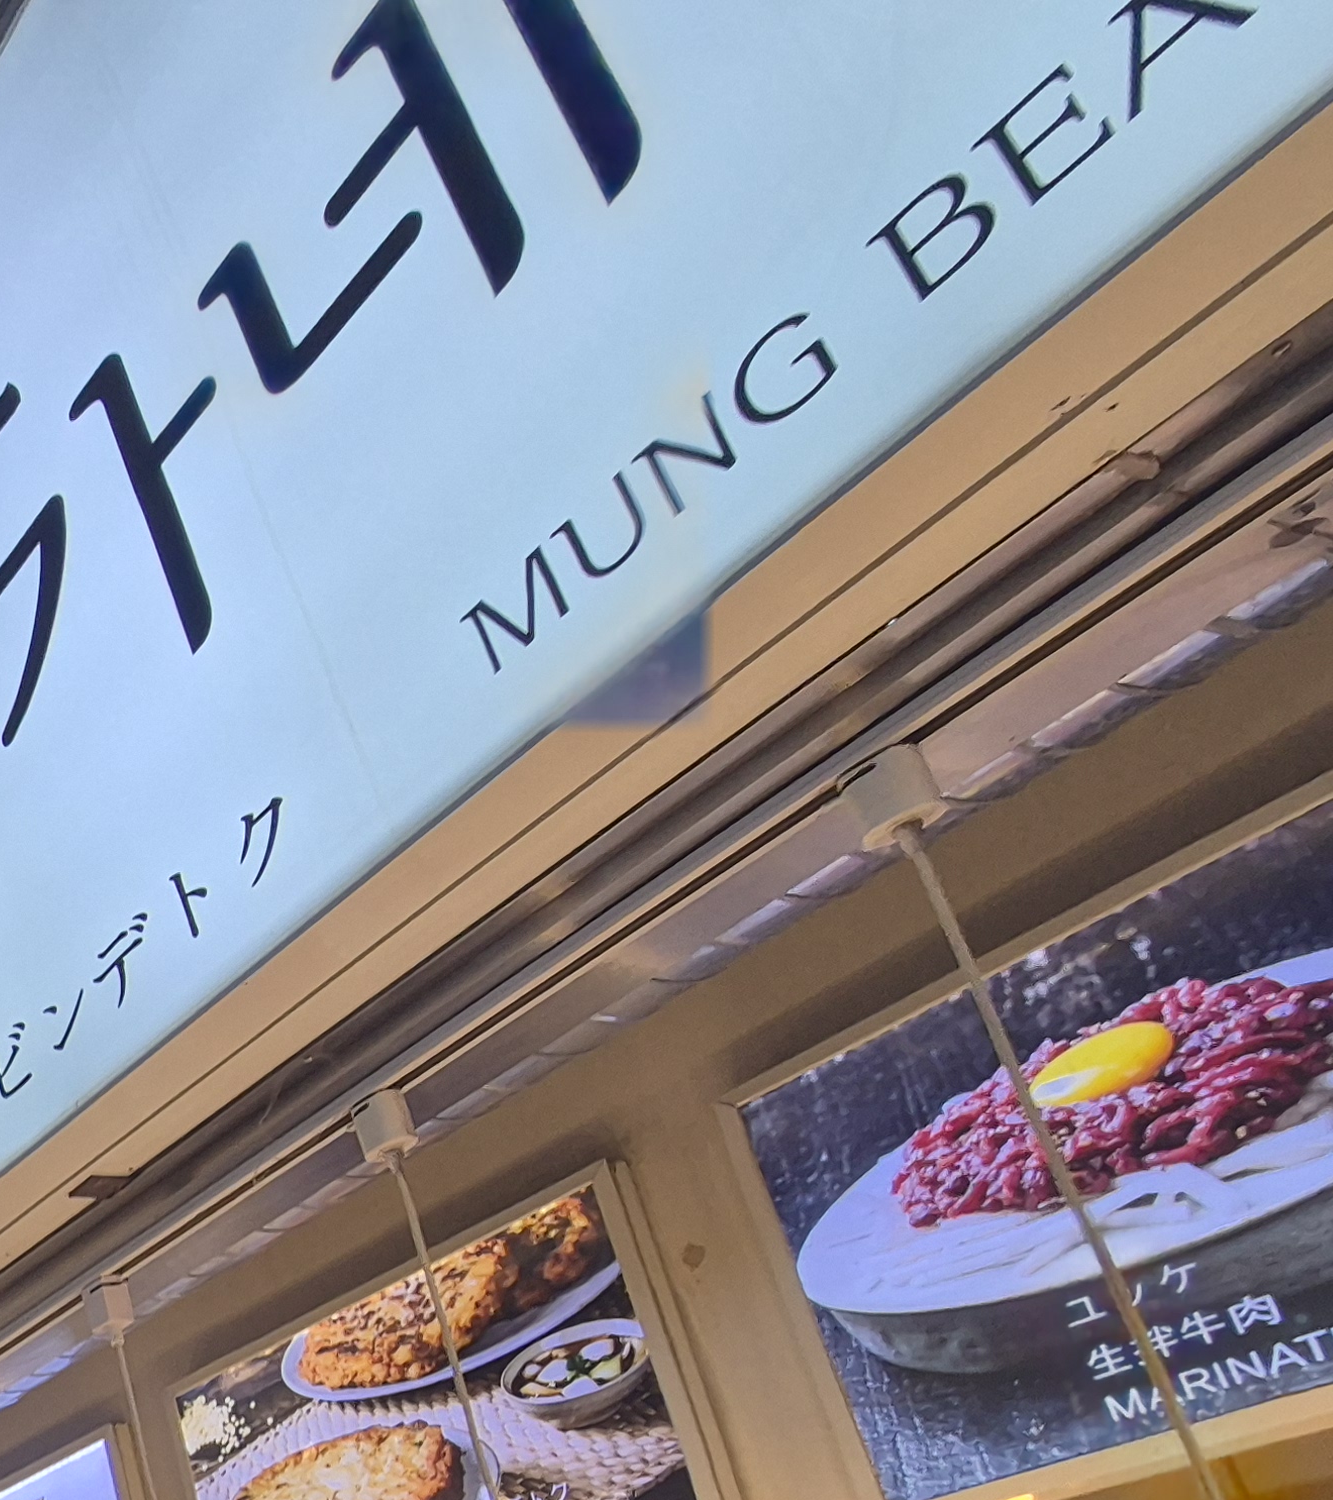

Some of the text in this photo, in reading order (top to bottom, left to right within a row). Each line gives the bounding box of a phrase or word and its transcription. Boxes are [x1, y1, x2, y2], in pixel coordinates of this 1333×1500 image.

[459, 0, 1256, 675] MUNG BEA
[1104, 1325, 1333, 1423] MARINAT
